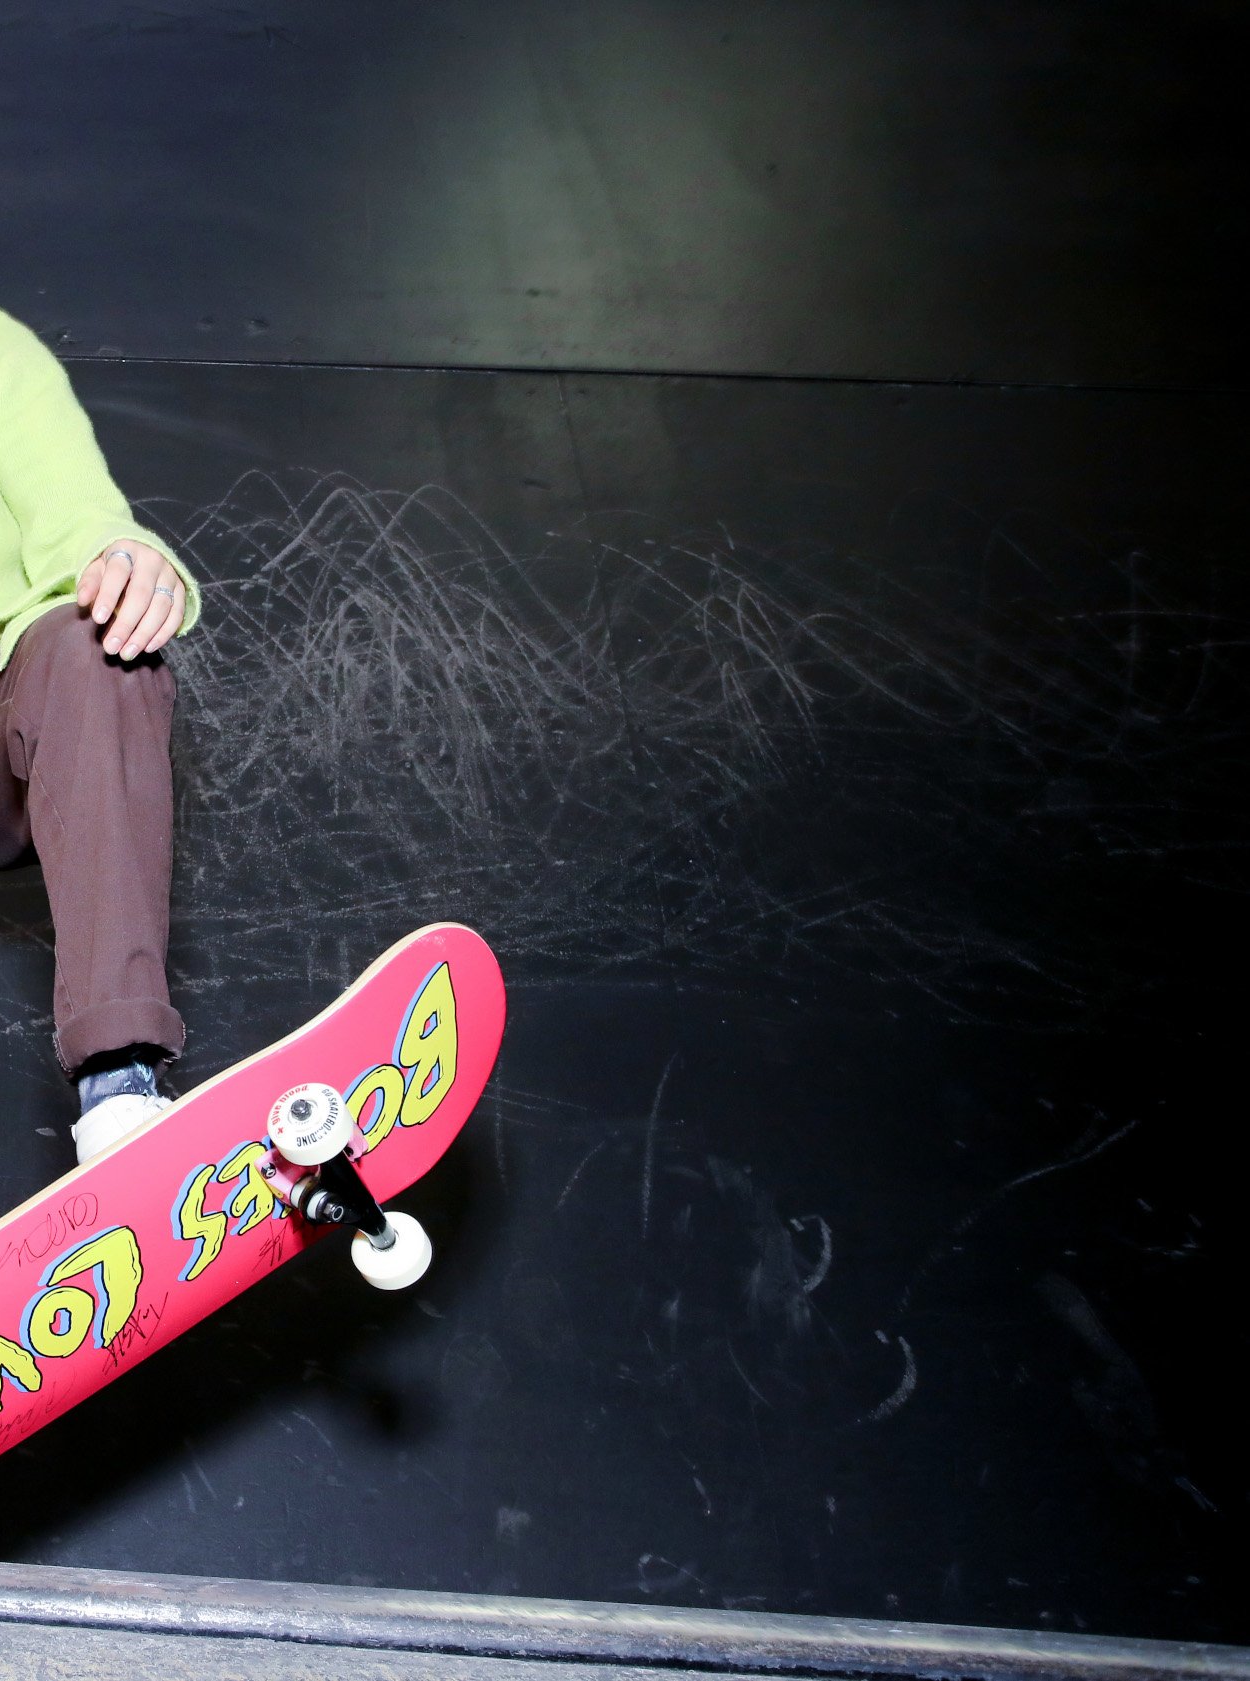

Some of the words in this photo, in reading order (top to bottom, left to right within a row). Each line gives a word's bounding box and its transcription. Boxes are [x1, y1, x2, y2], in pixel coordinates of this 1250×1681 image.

[322, 1088, 333, 1097] GO
[171, 961, 458, 1281] BOES
[271, 1105, 282, 1125] give
